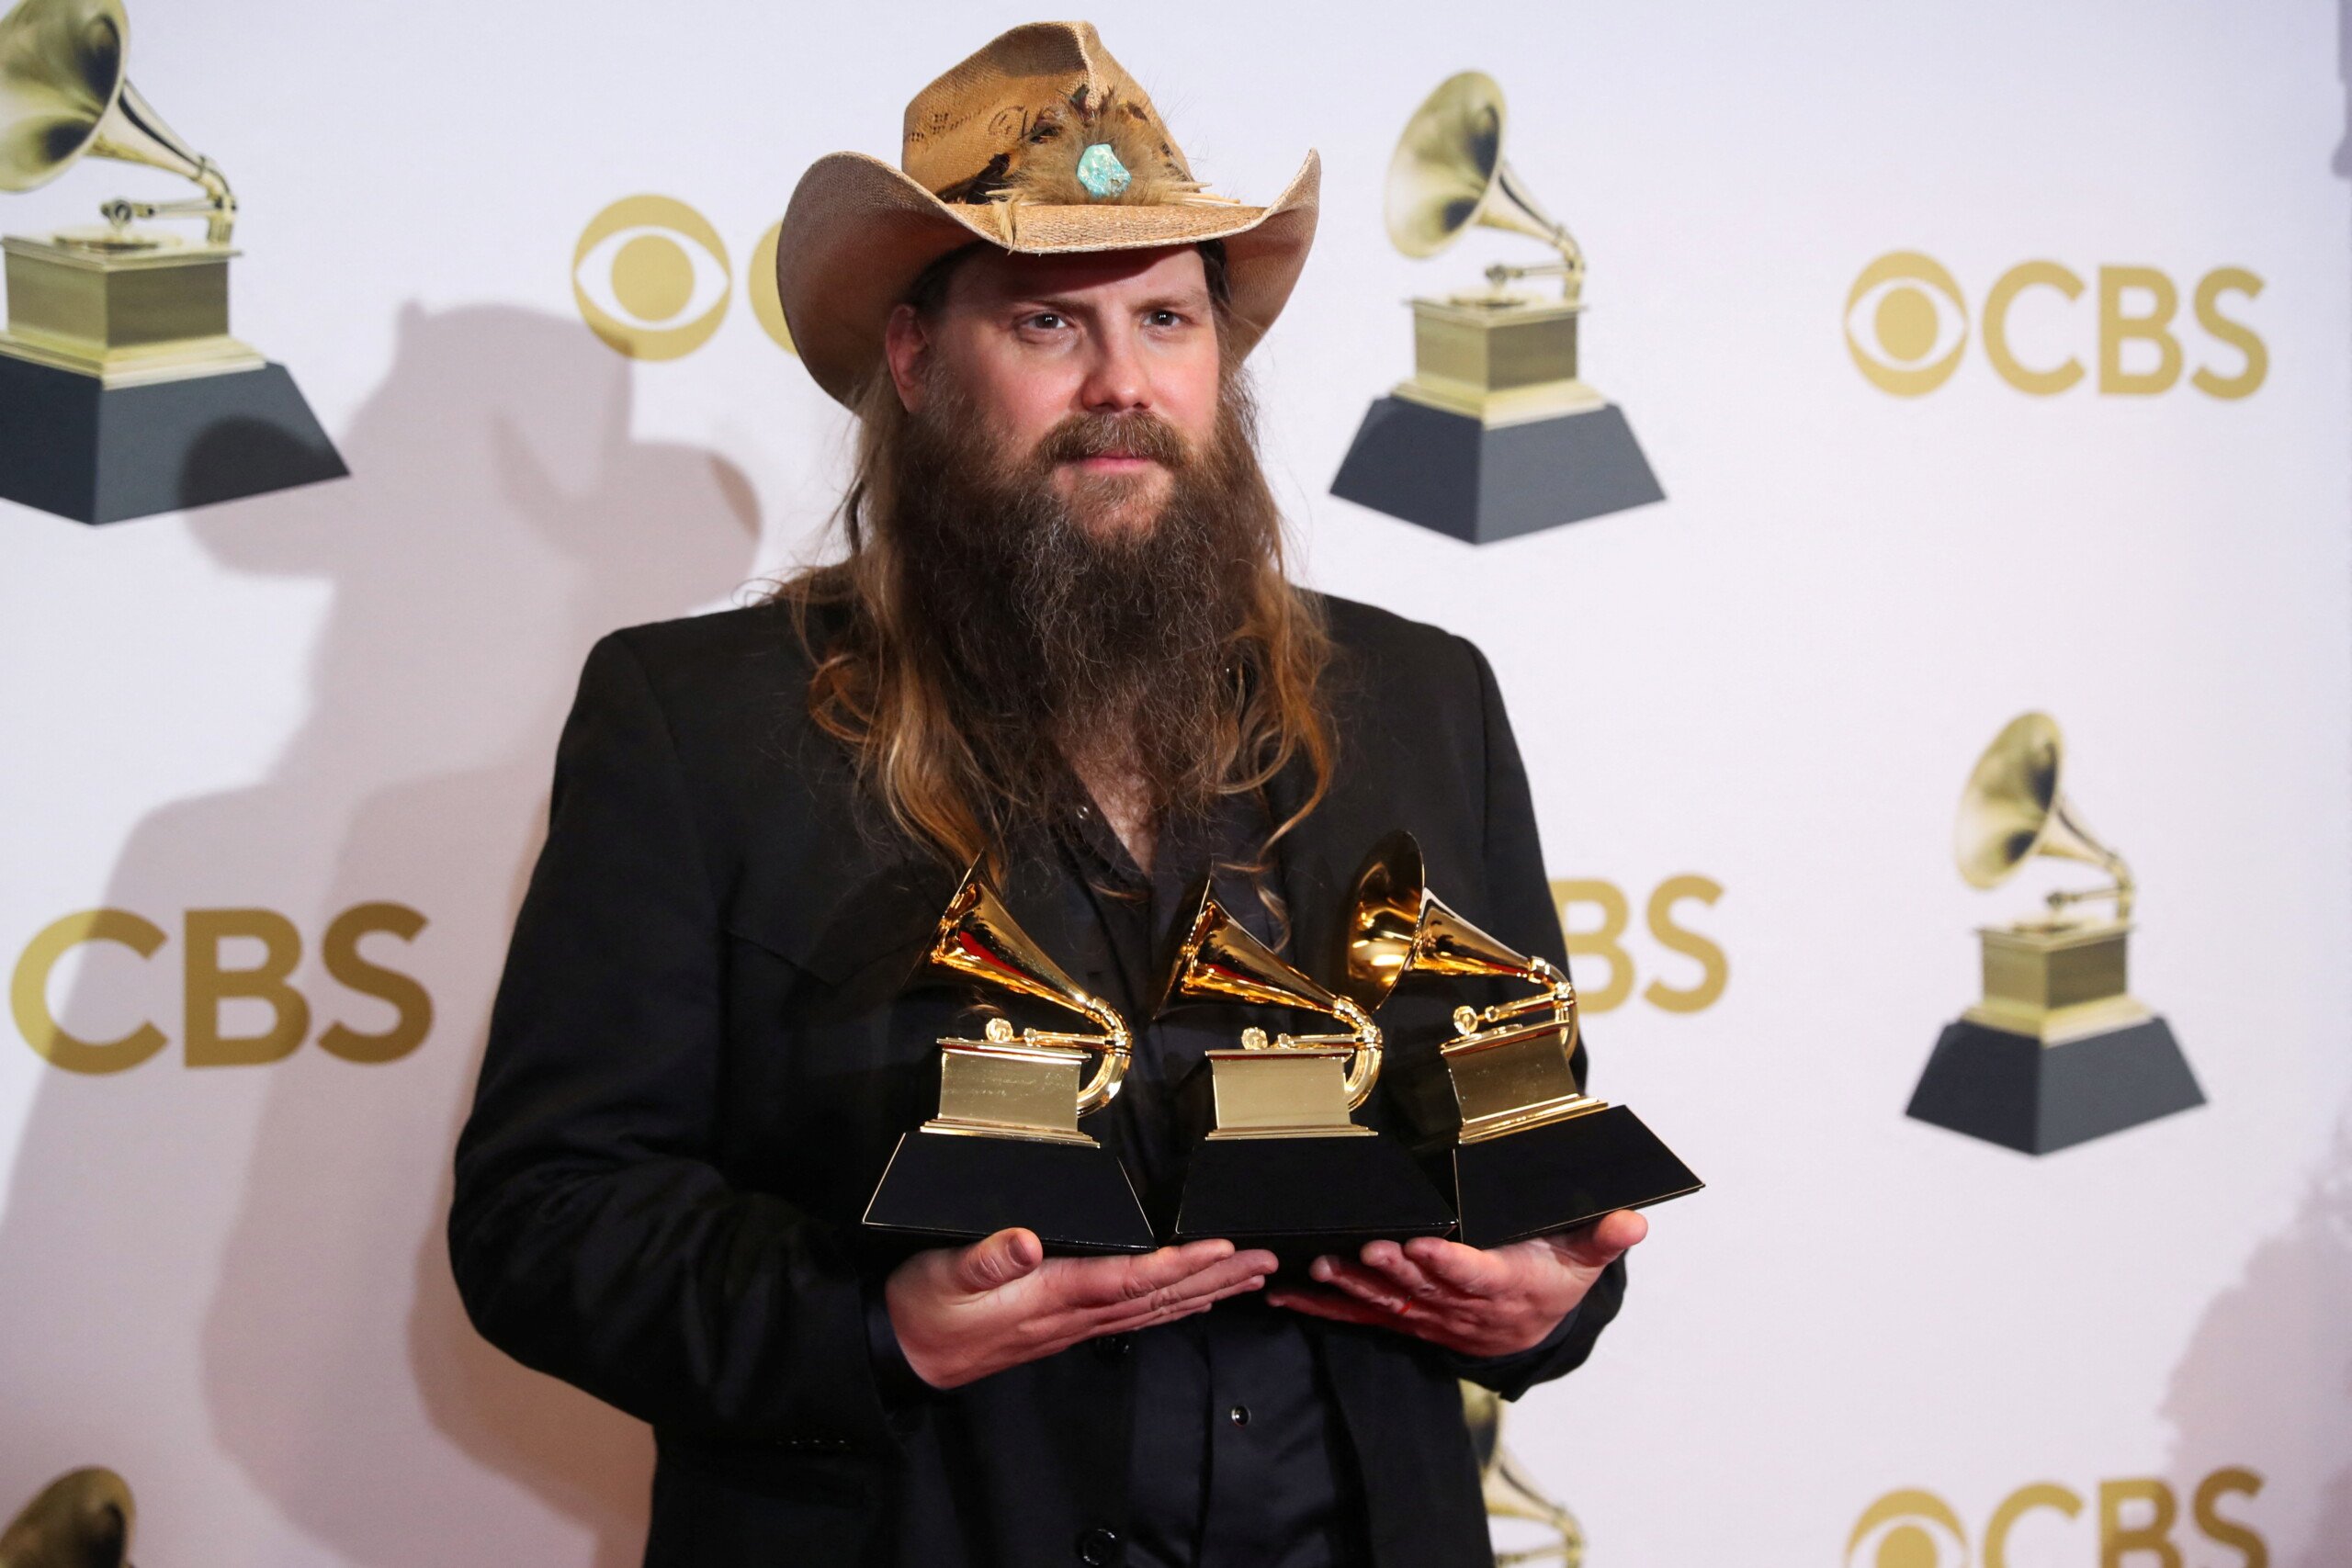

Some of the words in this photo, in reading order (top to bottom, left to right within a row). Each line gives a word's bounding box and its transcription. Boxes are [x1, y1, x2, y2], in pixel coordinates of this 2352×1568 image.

[1981, 259, 2269, 400] CBS
[10, 901, 435, 1077] CBS
[1547, 874, 1729, 1015] BS
[1981, 1467, 2269, 1568] CBS
